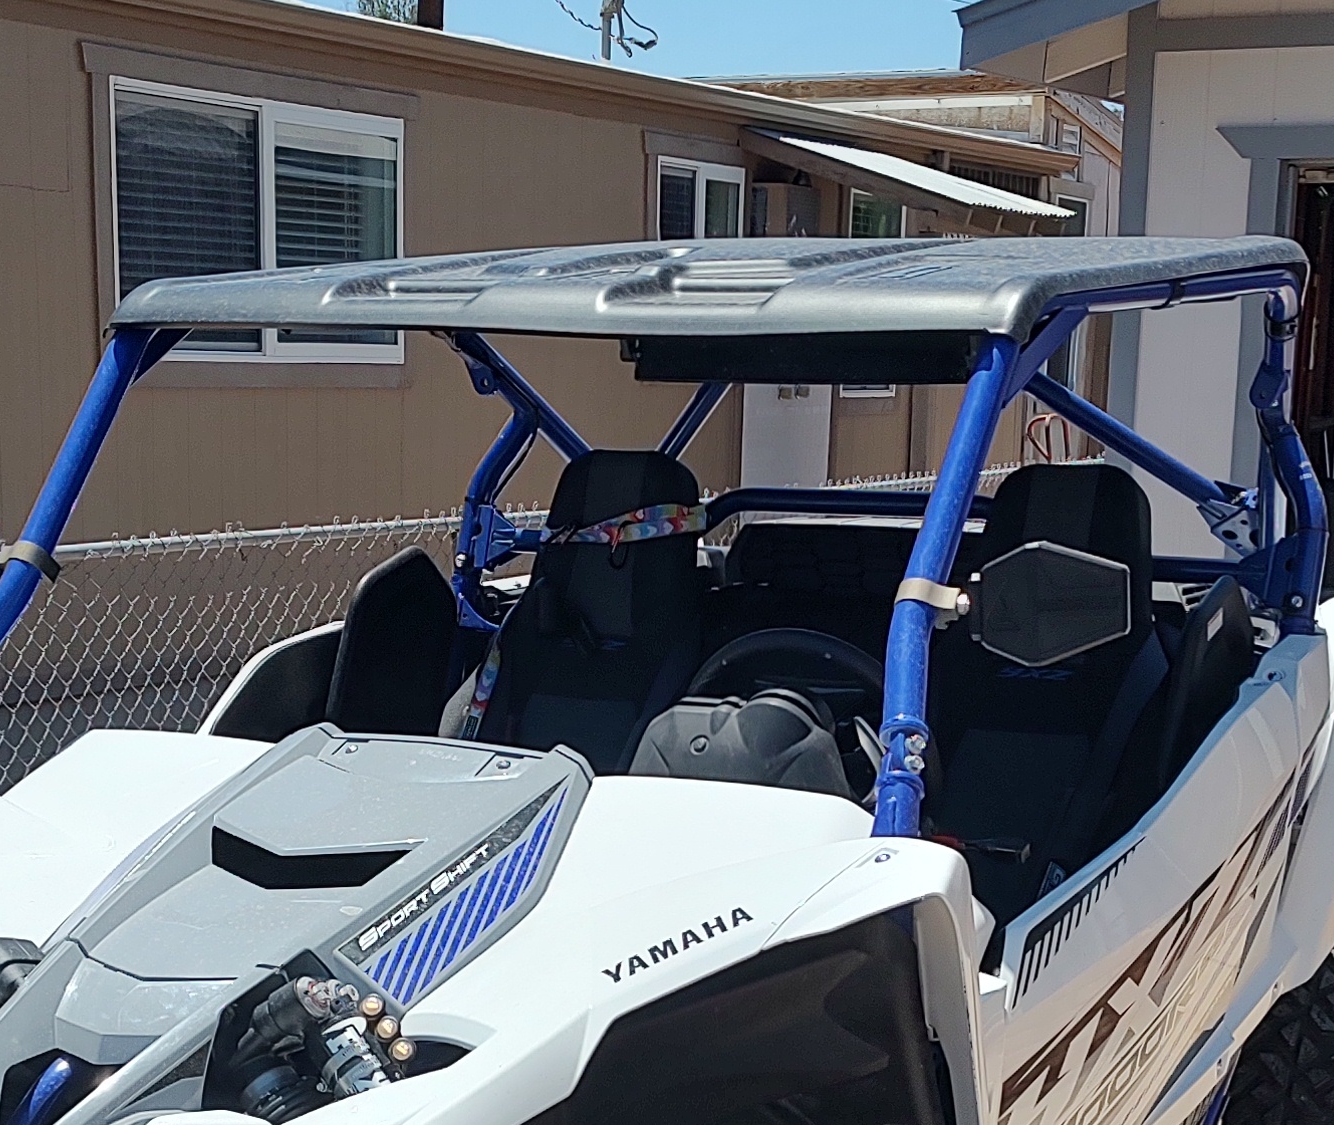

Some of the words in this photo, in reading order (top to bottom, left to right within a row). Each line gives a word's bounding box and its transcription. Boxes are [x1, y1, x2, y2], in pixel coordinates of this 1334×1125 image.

[358, 888, 430, 951] SPORT
[430, 843, 489, 895] SHIFT
[601, 906, 754, 984] YAMAHA
